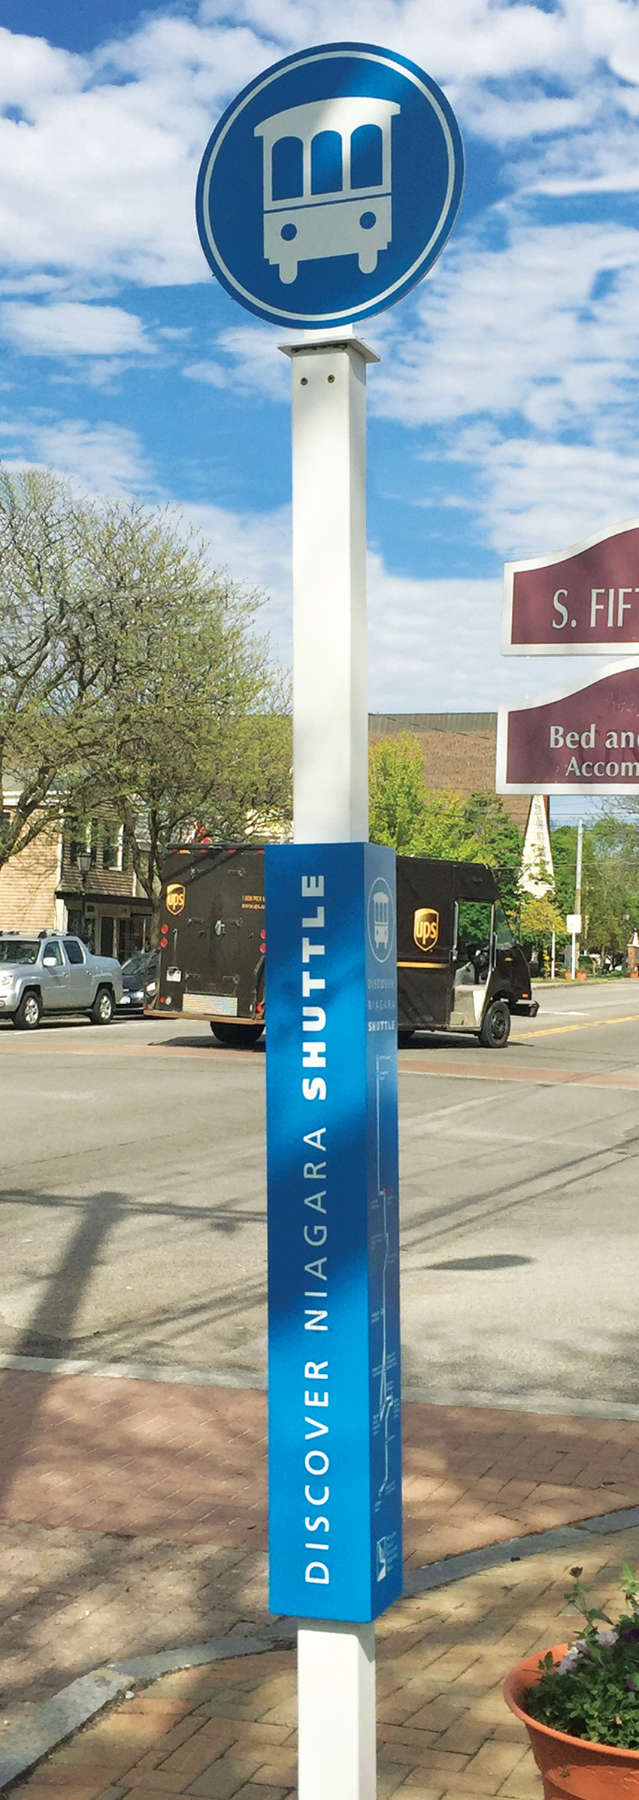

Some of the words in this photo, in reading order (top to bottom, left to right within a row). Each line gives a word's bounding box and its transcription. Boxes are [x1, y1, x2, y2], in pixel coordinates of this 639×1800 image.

[552, 588, 577, 629] S.
[550, 723, 596, 749] Bed
[605, 731, 639, 749] an
[565, 756, 639, 777] Accom
[167, 893, 184, 910] ups
[416, 921, 437, 945] ups
[302, 876, 326, 1100] SHUTTLE
[367, 1020, 396, 1032] SHUTTLE
[303, 1128, 328, 1331] NIAGARA
[305, 1362, 329, 1584] DISCOVER
